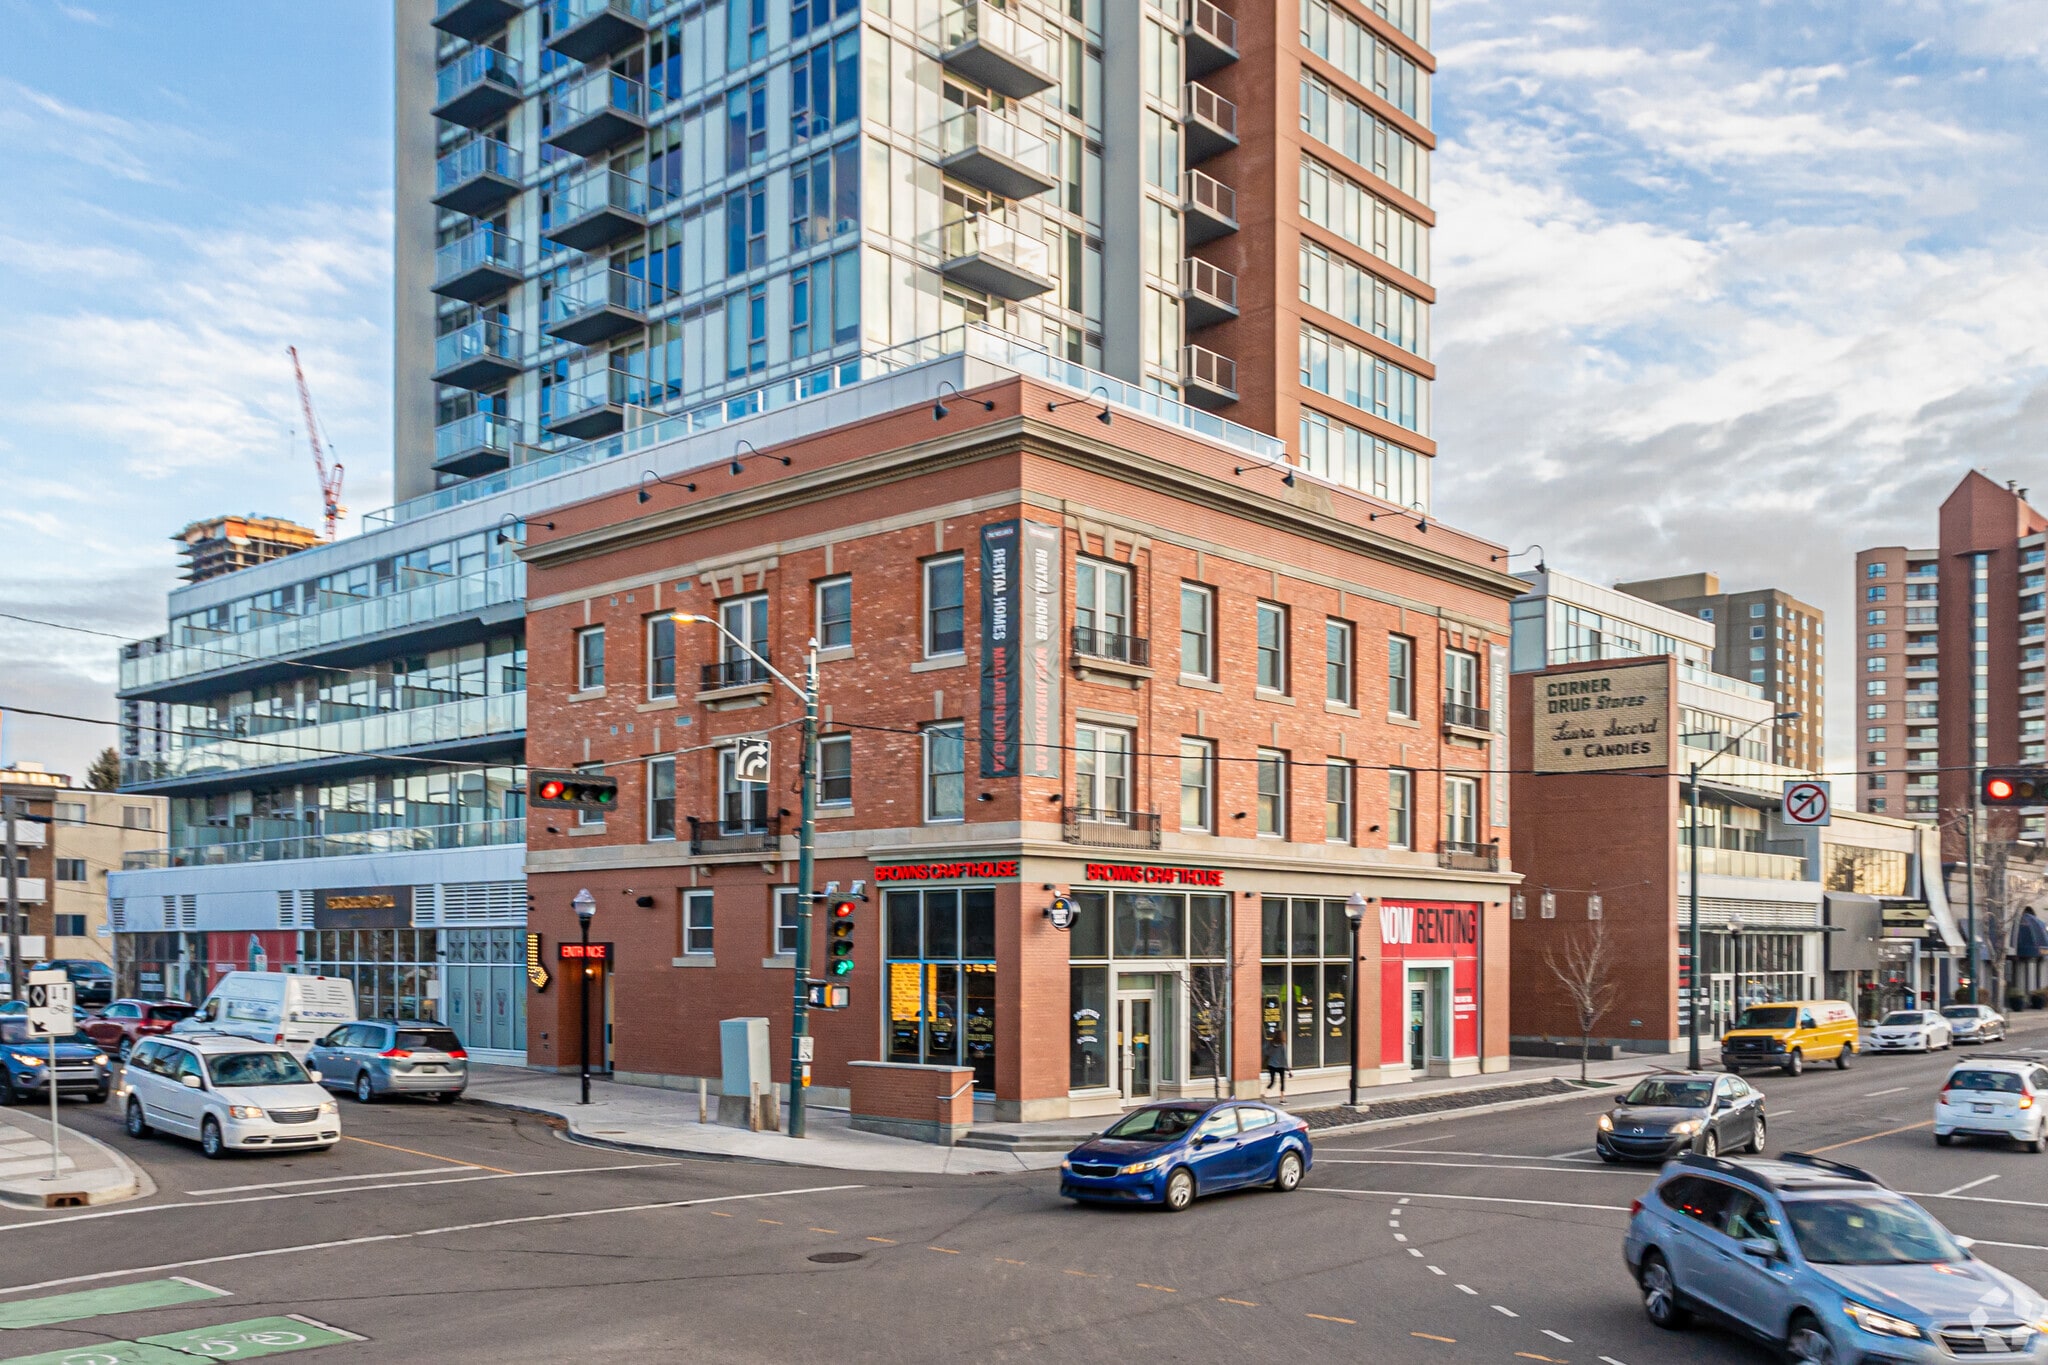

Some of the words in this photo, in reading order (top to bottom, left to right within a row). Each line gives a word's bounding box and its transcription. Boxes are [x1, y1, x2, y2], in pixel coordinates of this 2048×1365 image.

[992, 548, 1006, 596] RENTAL
[1035, 548, 1048, 594] RENTAL
[992, 597, 1007, 640] HOMES
[1035, 597, 1048, 640] HOMES
[1547, 678, 1611, 697] CORNER
[1548, 697, 1591, 714] DRUG
[1596, 695, 1647, 710] Stores
[1583, 742, 1651, 758] CANDIES
[874, 863, 927, 881] BROWNS
[929, 860, 1018, 880] CRAFTHOUSE
[1086, 863, 1144, 883] BROWNS
[1145, 865, 1225, 887] CRAFTHOUSE
[1416, 908, 1476, 944] RENTING
[561, 945, 606, 958] ENTRNCE
